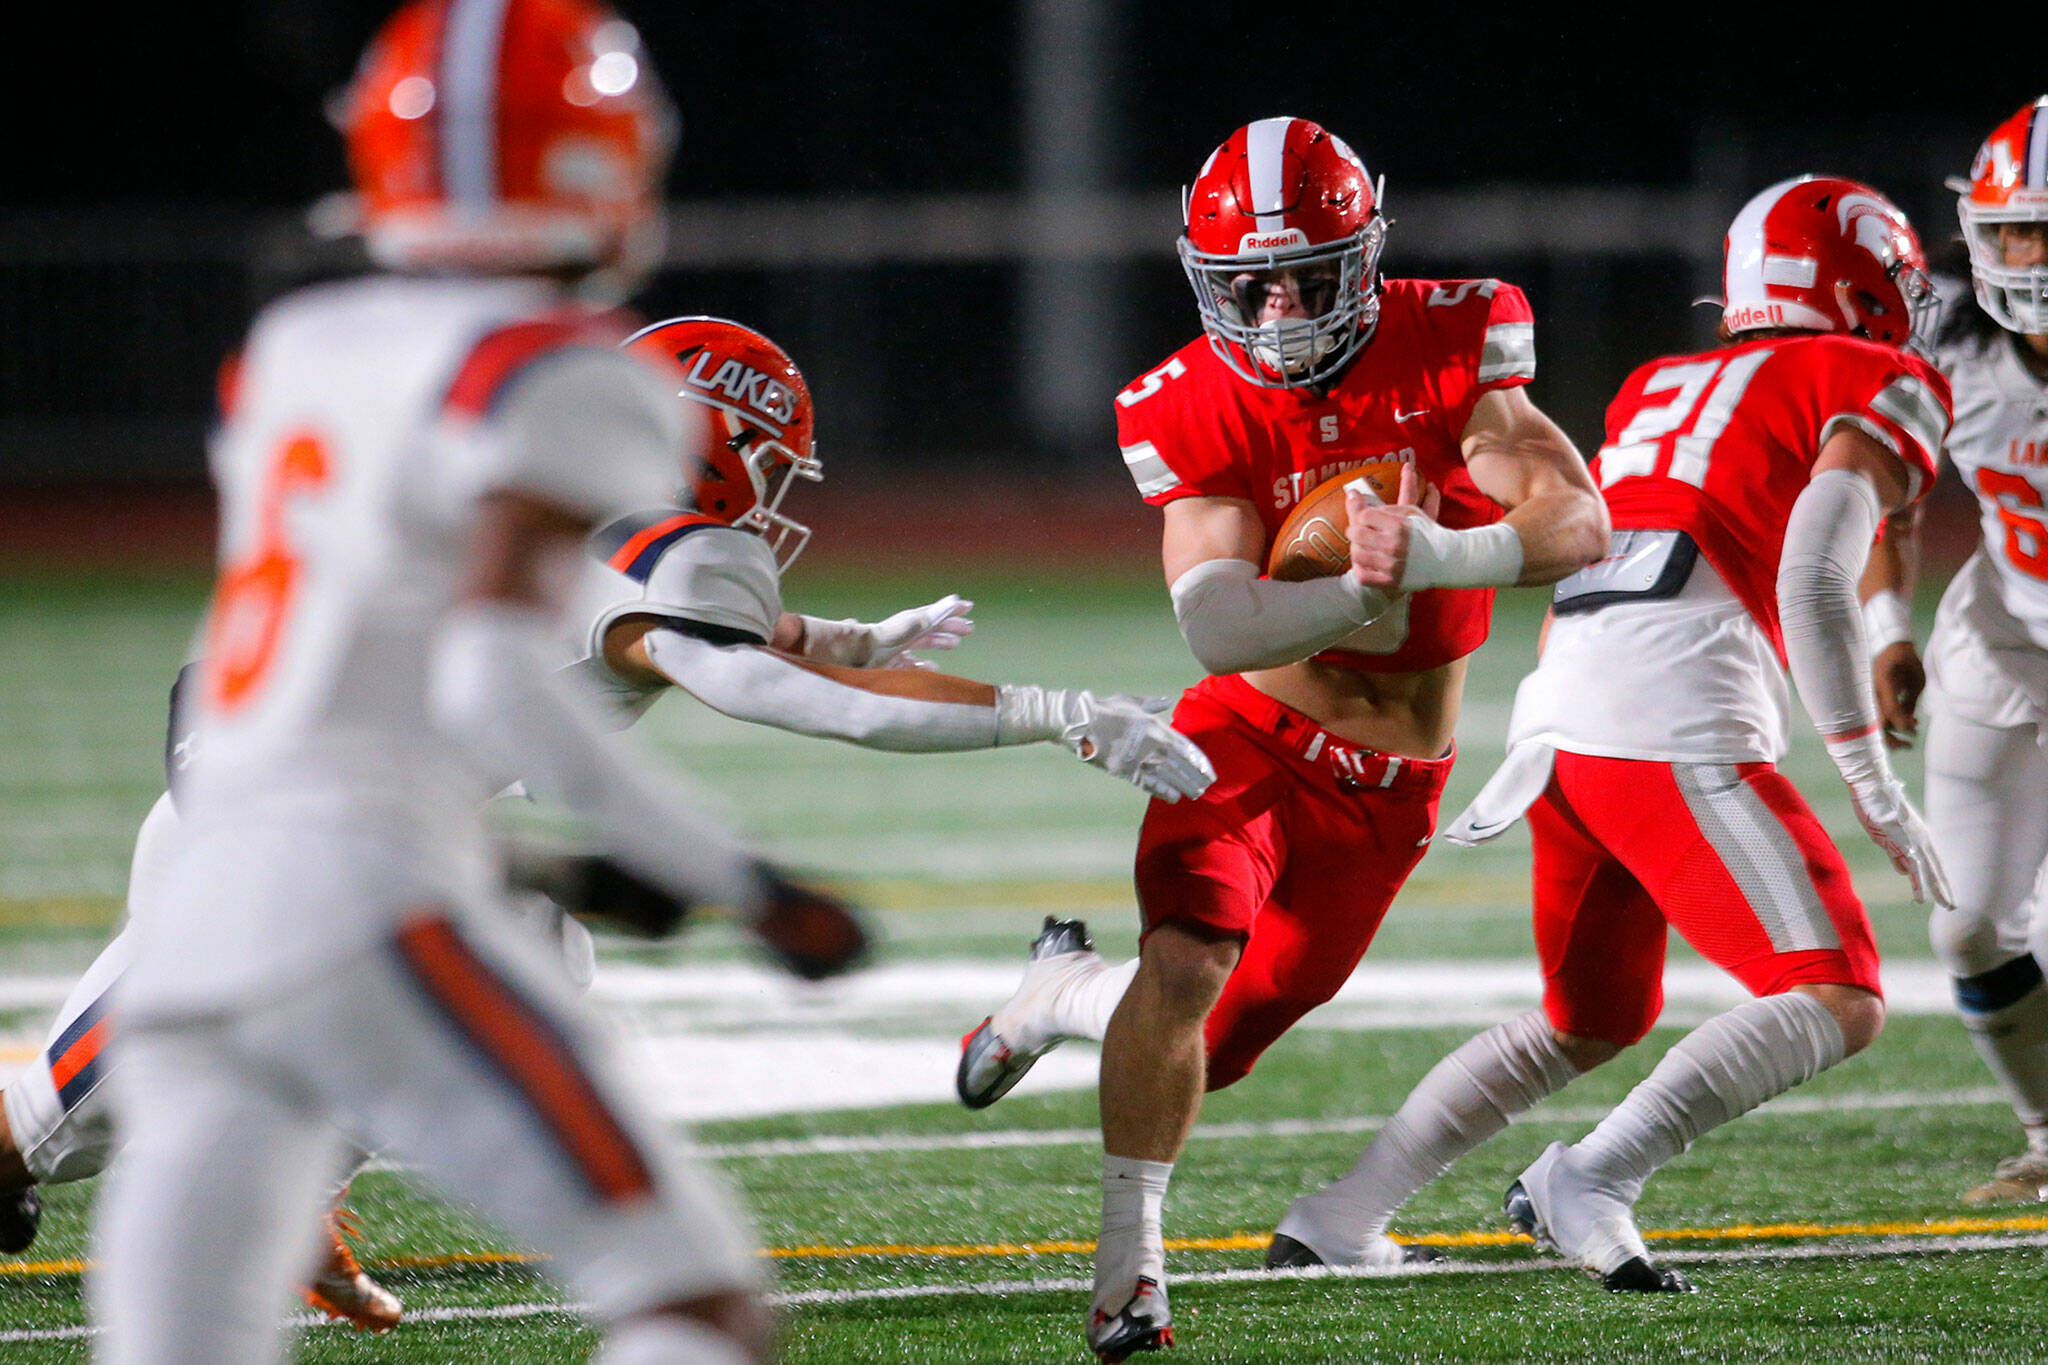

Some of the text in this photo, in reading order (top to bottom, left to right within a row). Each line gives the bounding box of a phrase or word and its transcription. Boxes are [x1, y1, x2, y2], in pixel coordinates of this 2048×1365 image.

[1247, 233, 1299, 249] Riddell
[685, 350, 799, 426] LAKES
[1115, 357, 1187, 408] 5
[1319, 415, 1339, 443] S
[1599, 349, 1776, 492] 21
